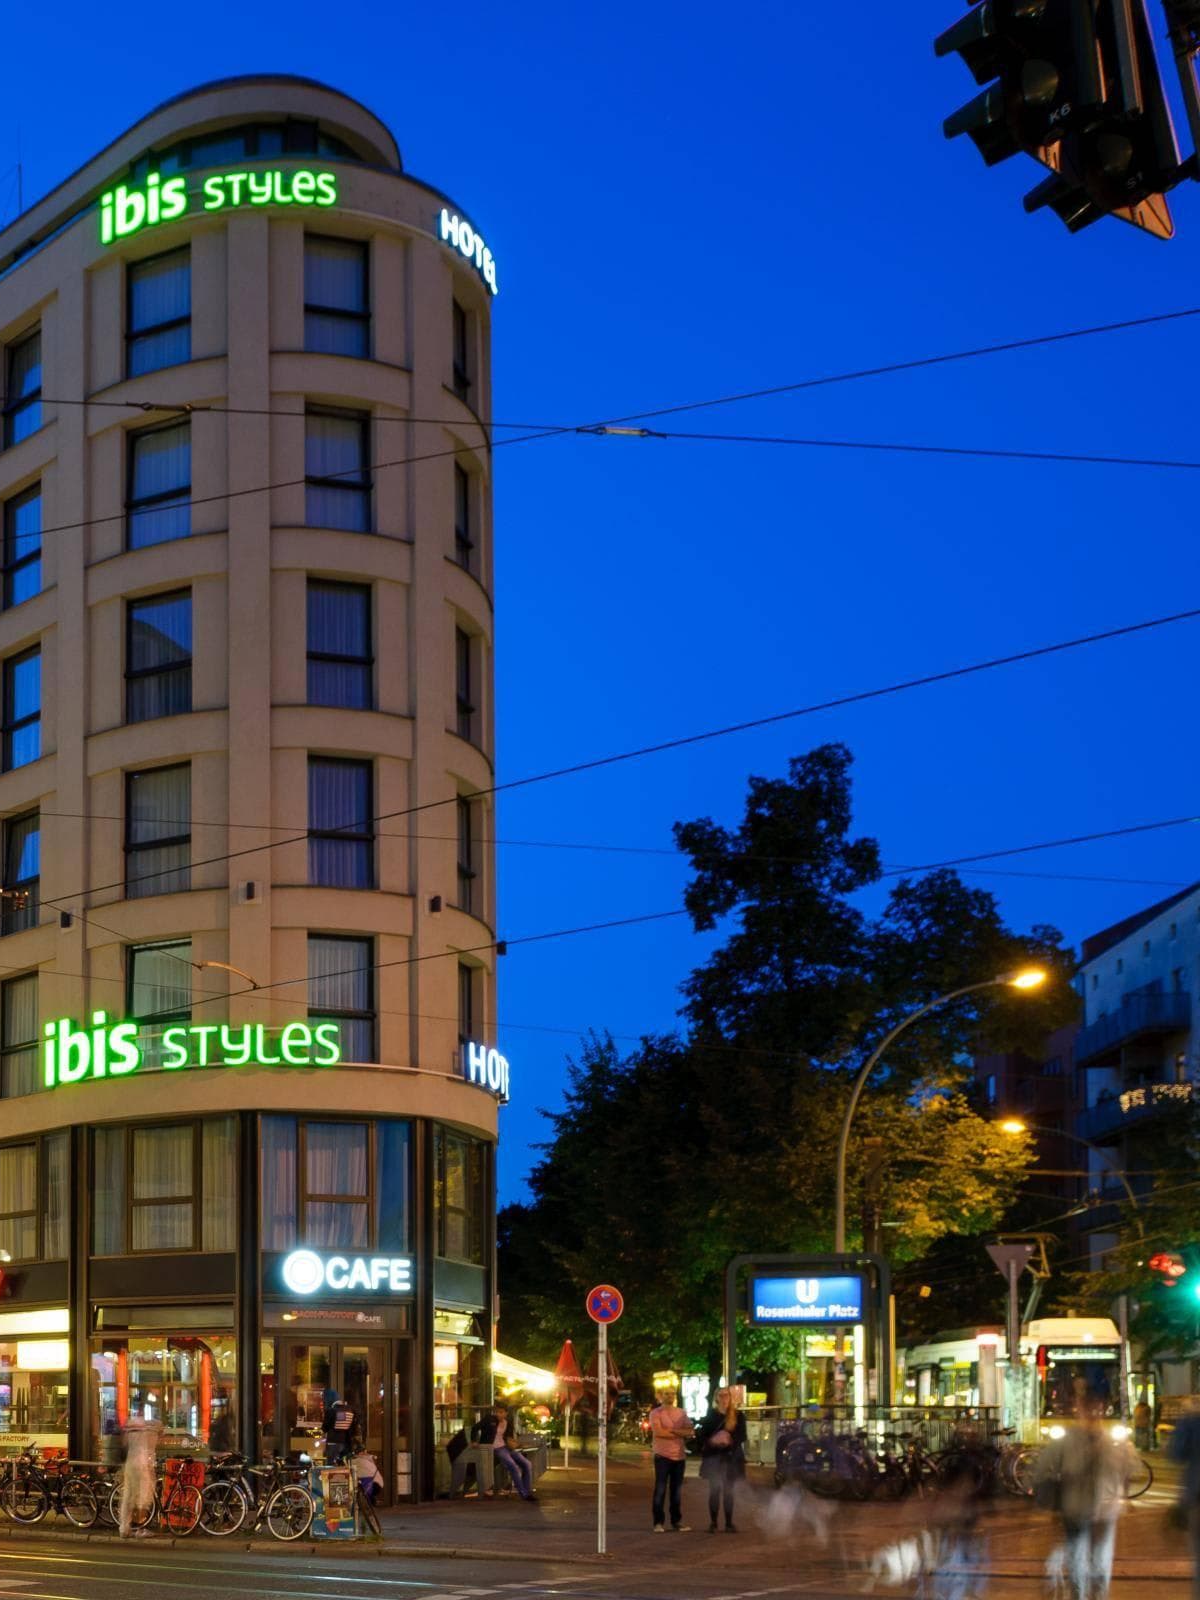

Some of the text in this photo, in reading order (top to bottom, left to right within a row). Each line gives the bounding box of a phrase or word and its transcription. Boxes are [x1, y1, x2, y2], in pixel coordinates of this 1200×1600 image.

[101, 171, 187, 244] ibis
[441, 208, 499, 295] HOTEL
[44, 1010, 140, 1087] ibis
[325, 1256, 411, 1290] CAFE
[795, 1279, 820, 1304] U
[756, 1304, 859, 1318] Rosenthaler Platz
